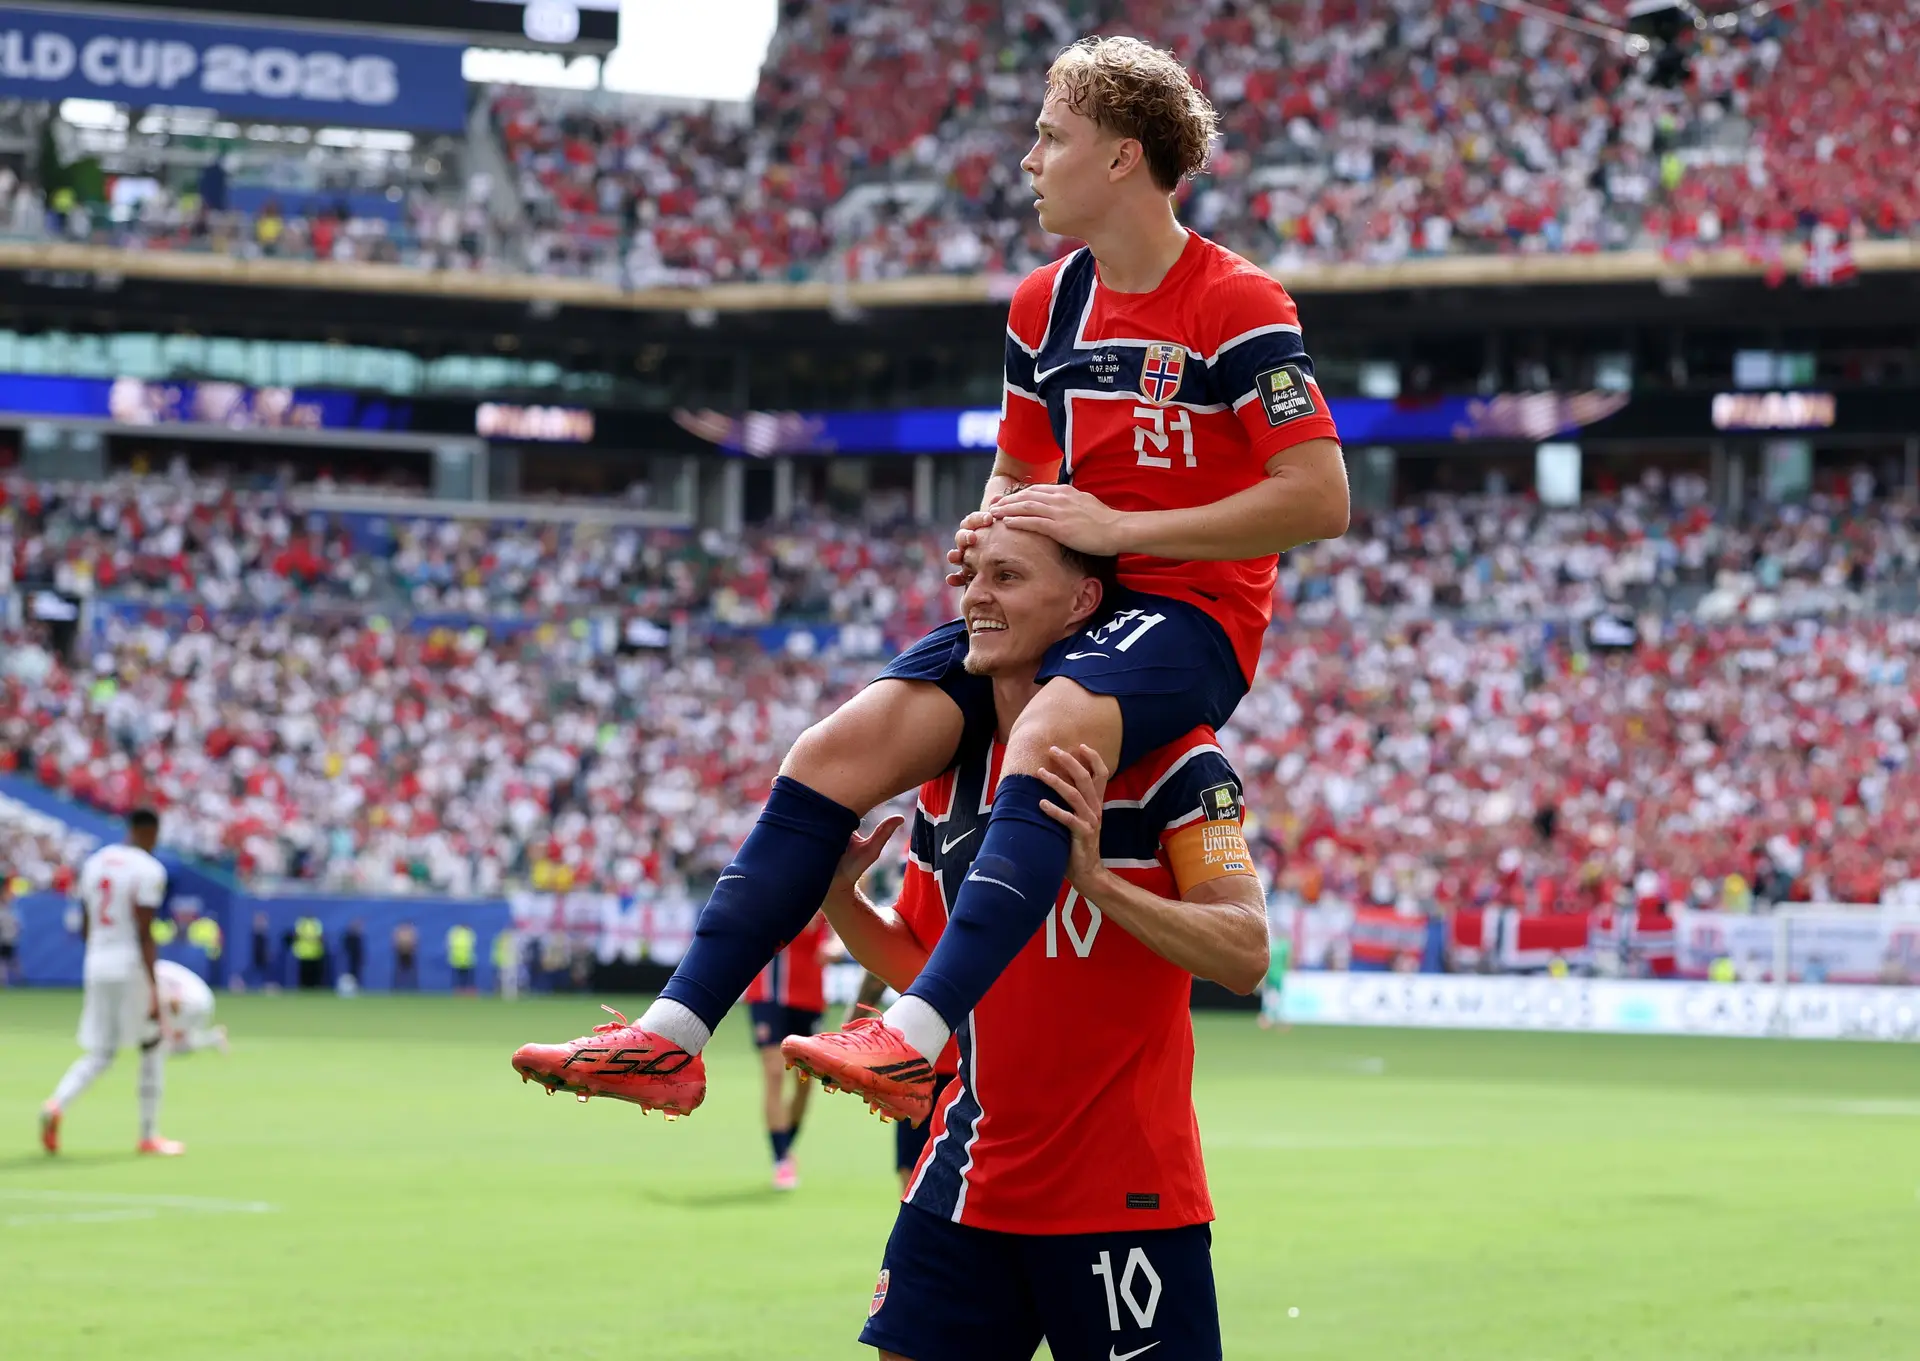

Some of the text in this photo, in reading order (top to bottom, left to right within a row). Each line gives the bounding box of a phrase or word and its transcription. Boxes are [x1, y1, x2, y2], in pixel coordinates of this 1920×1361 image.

[0, 29, 398, 105] LD CUP 2026
[1288, 388, 1298, 398] For
[1271, 396, 1307, 414] EDUCATION
[1284, 408, 1299, 416] FIFA
[1133, 406, 1197, 469] 21
[1202, 825, 1240, 838] FOOTBALL
[1203, 836, 1247, 852] UNITES
[1202, 851, 1223, 864] the
[560, 1048, 694, 1075] F50
[1092, 1247, 1162, 1331] 10
